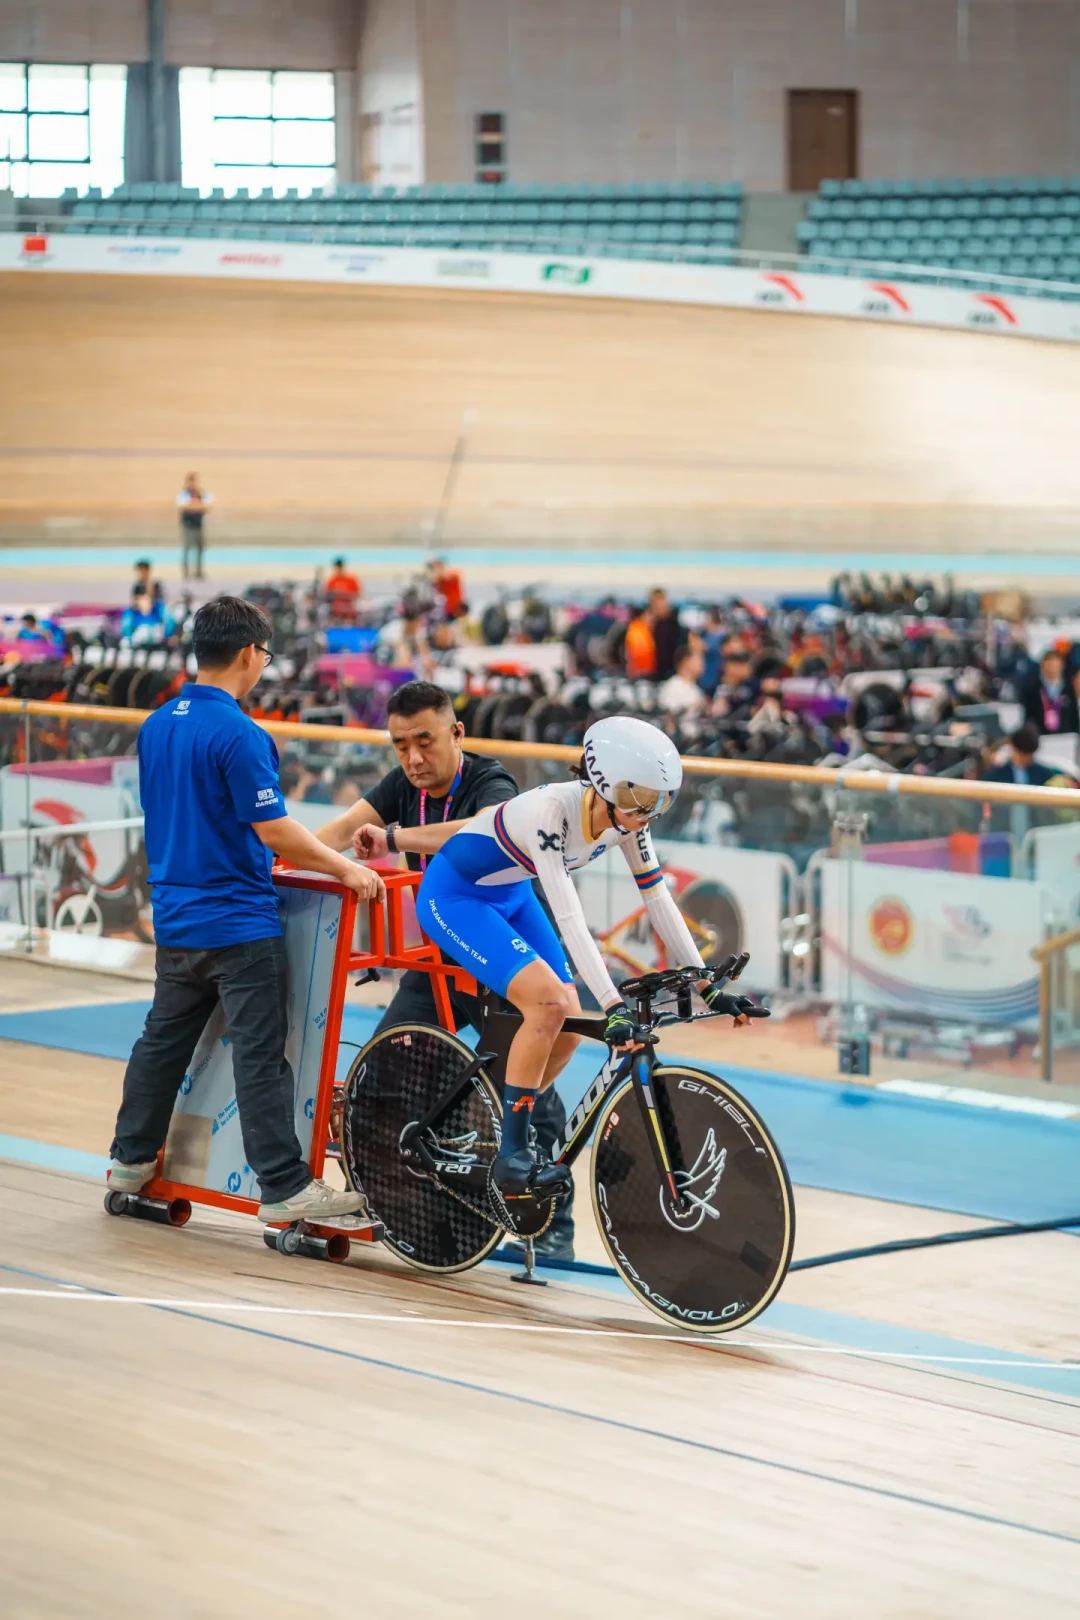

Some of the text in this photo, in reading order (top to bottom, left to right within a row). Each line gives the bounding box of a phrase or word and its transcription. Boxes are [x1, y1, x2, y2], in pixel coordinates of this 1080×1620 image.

[585, 739, 610, 794] KASK
[429, 899, 488, 966] ZHEJIANG CYCLING TEAM
[551, 1048, 626, 1162] LOOK
[434, 1162, 472, 1174] T20
[598, 1181, 740, 1321] CAMPAGNOLO
